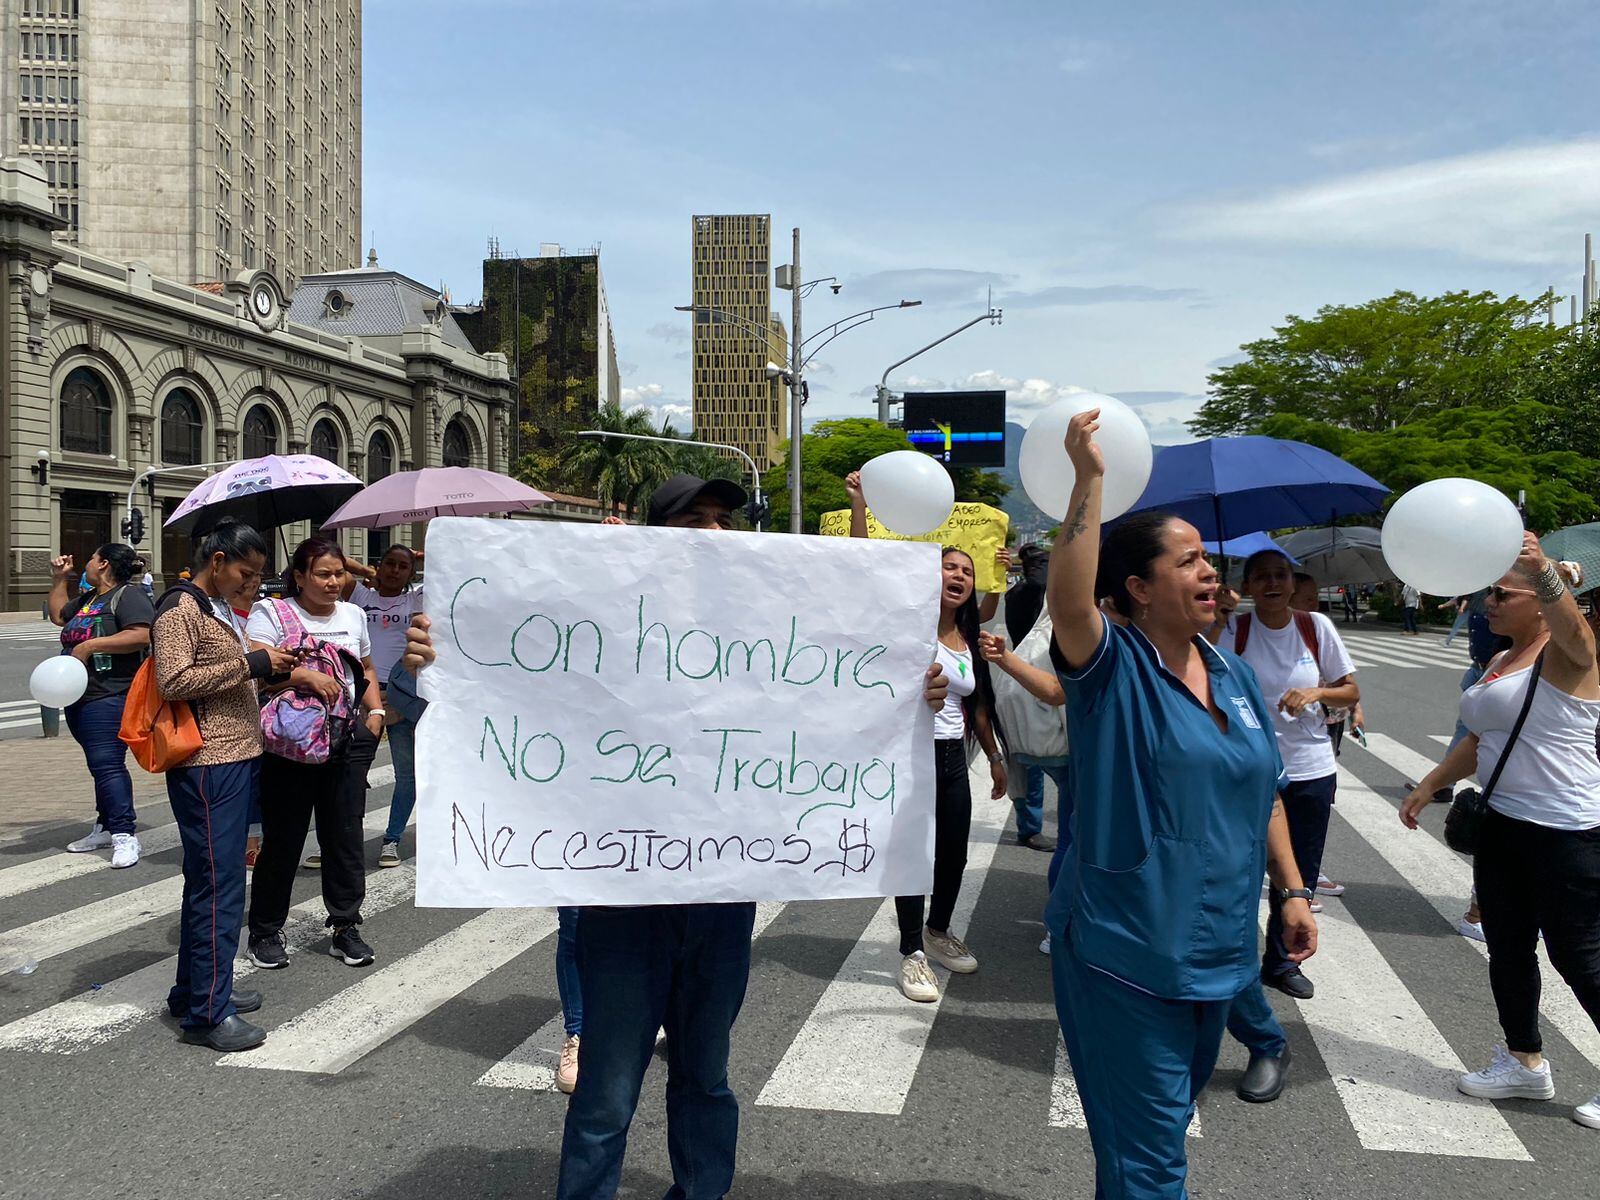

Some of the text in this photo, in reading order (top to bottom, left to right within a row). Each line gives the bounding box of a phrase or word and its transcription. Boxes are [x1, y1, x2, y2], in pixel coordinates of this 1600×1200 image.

[187, 323, 331, 374] ESTACION MEDELLIN
[383, 614, 401, 623] DO
[450, 577, 895, 698] Con hambre
[590, 730, 676, 787] Se
[701, 729, 896, 831] Trabaja
[814, 818, 876, 877] $
